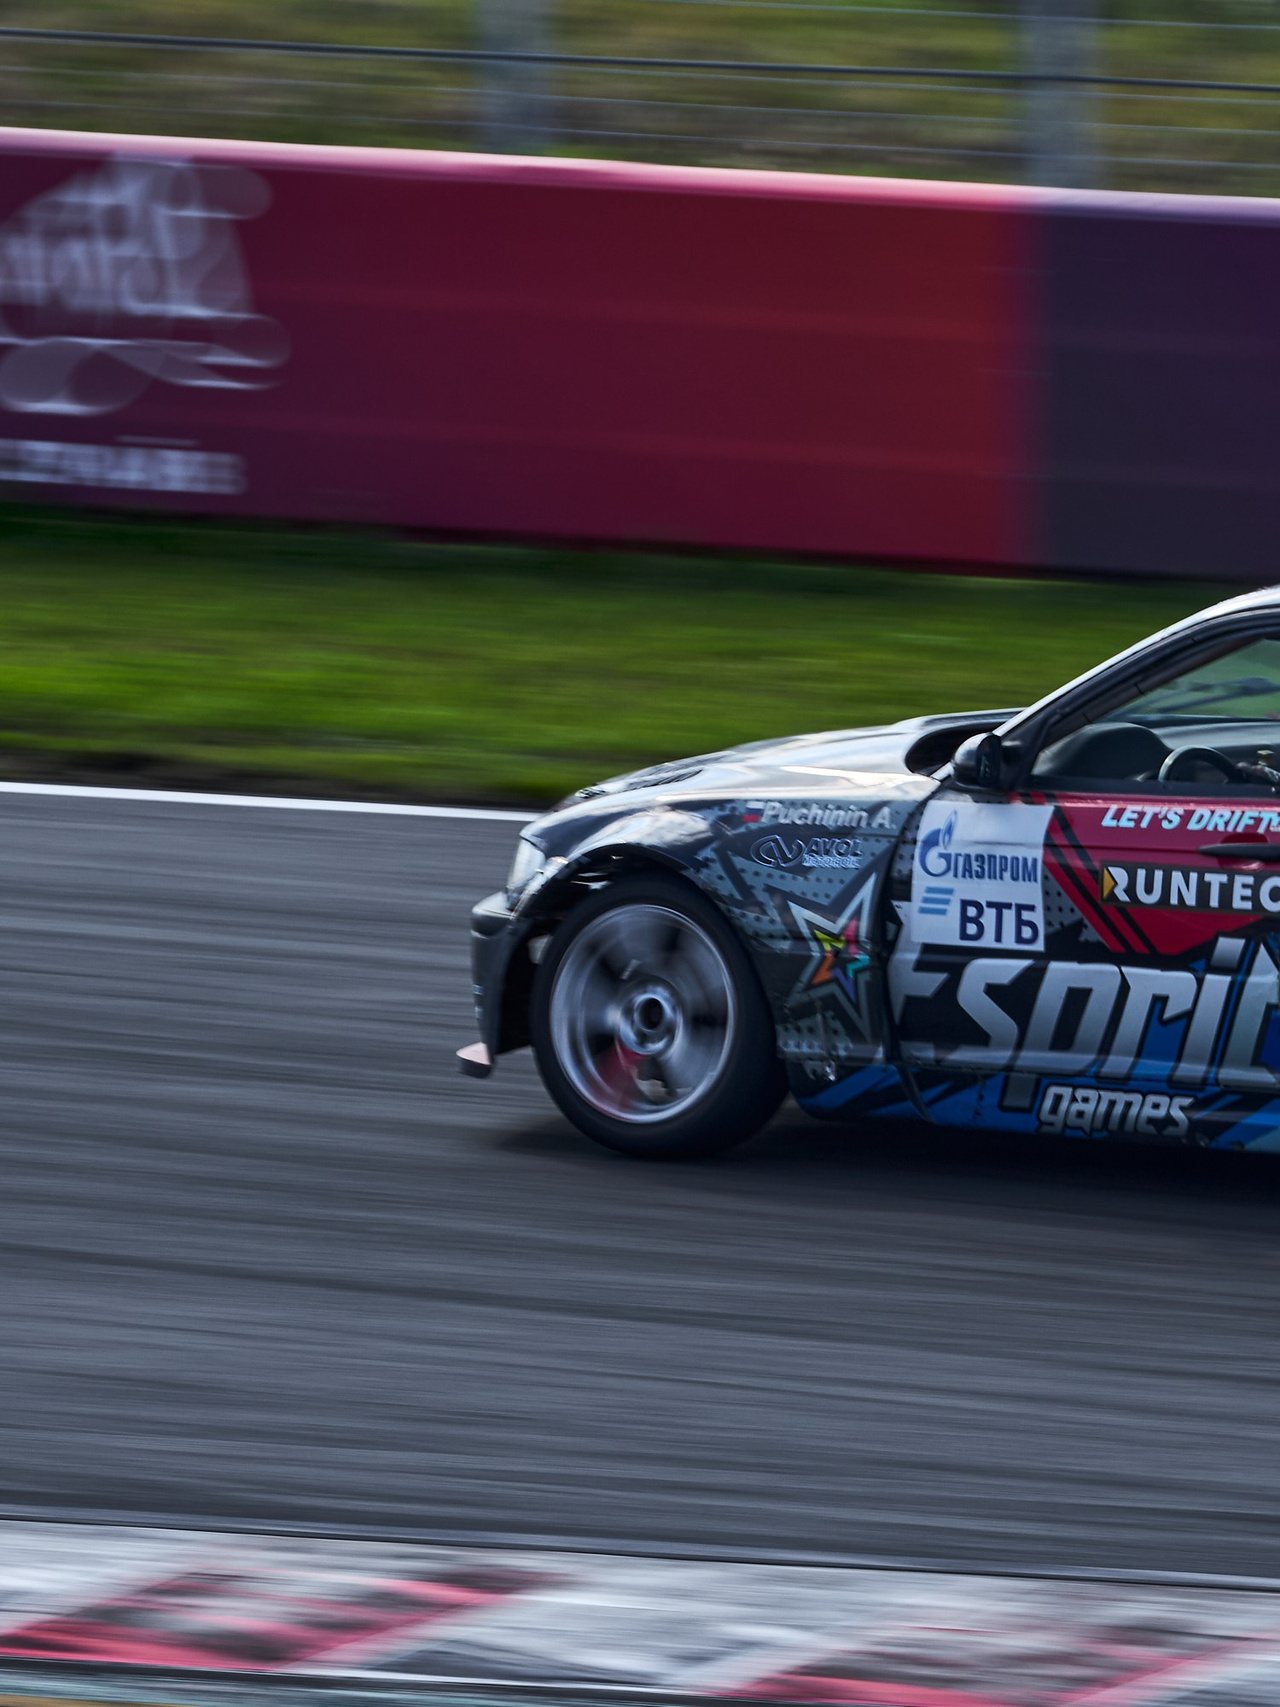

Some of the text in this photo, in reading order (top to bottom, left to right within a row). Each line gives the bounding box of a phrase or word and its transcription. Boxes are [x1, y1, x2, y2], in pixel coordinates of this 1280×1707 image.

[761, 801, 897, 829] Puchinin A.
[1101, 805, 1184, 830] LET'S
[803, 837, 863, 857] AVOL
[953, 853, 1038, 883] ГАЗПРОМ
[959, 898, 1039, 945] ВТБ
[1039, 1085, 1194, 1135] games
